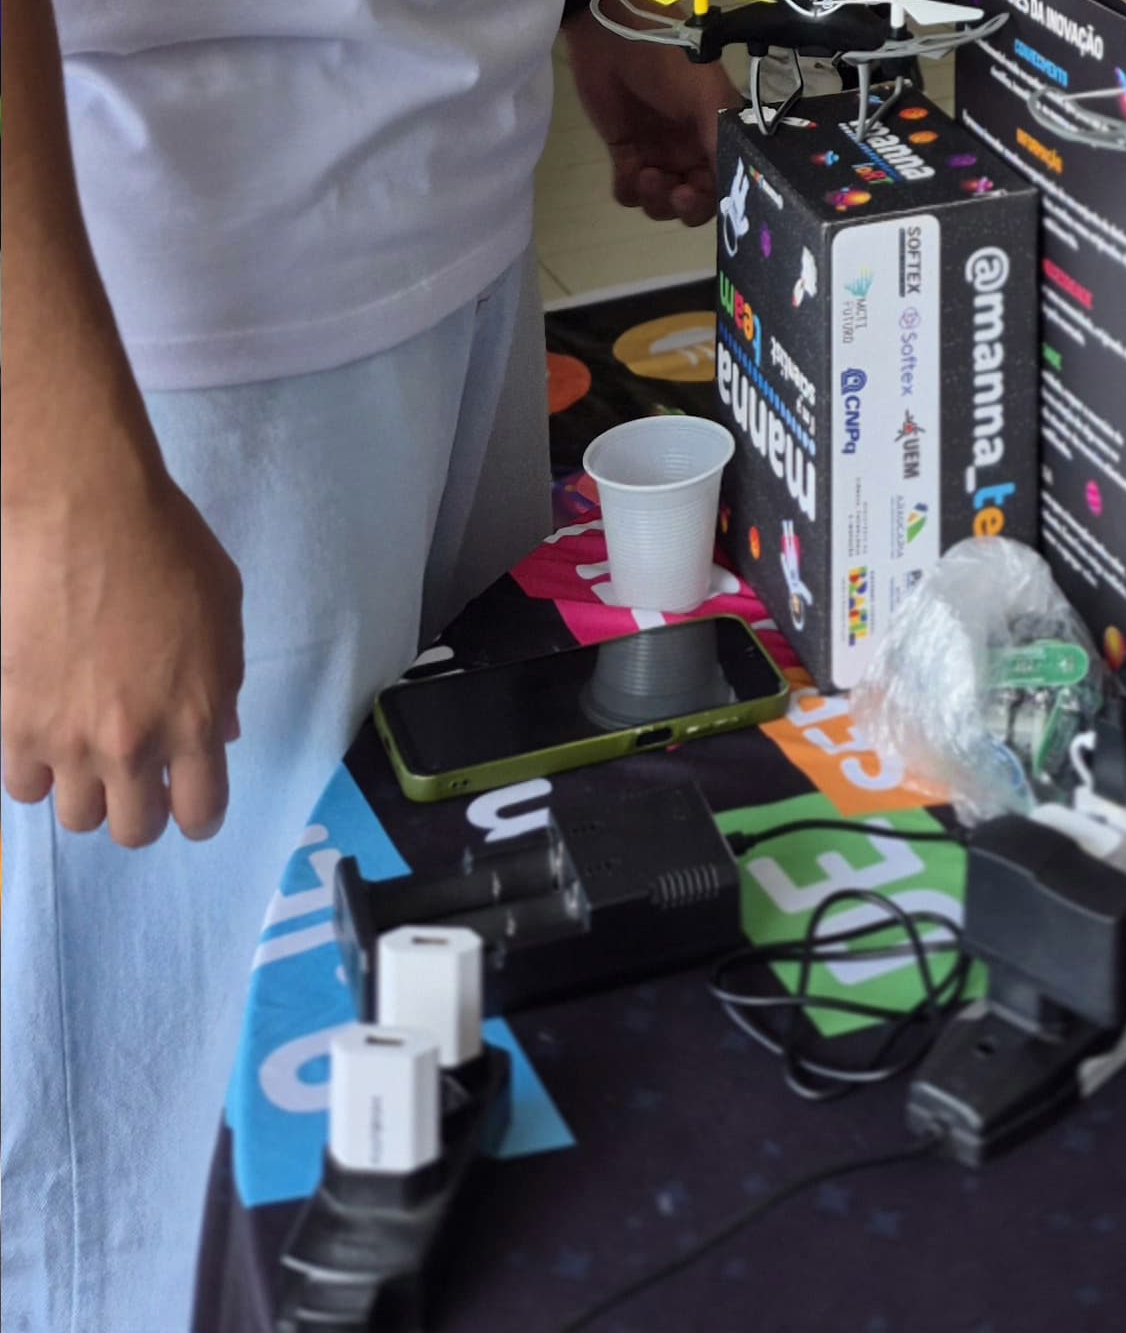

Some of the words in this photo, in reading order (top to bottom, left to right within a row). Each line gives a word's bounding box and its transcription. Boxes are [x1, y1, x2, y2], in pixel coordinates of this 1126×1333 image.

[1046, 5, 1105, 61] INOVAÇÃO
[906, 226, 922, 295] SOFTEX
[719, 269, 761, 367] team
[900, 331, 918, 396] Softex
[965, 246, 1017, 540] @manna_te
[717, 341, 817, 522] manna
[842, 395, 861, 455] CNPq
[903, 437, 921, 480] UEM
